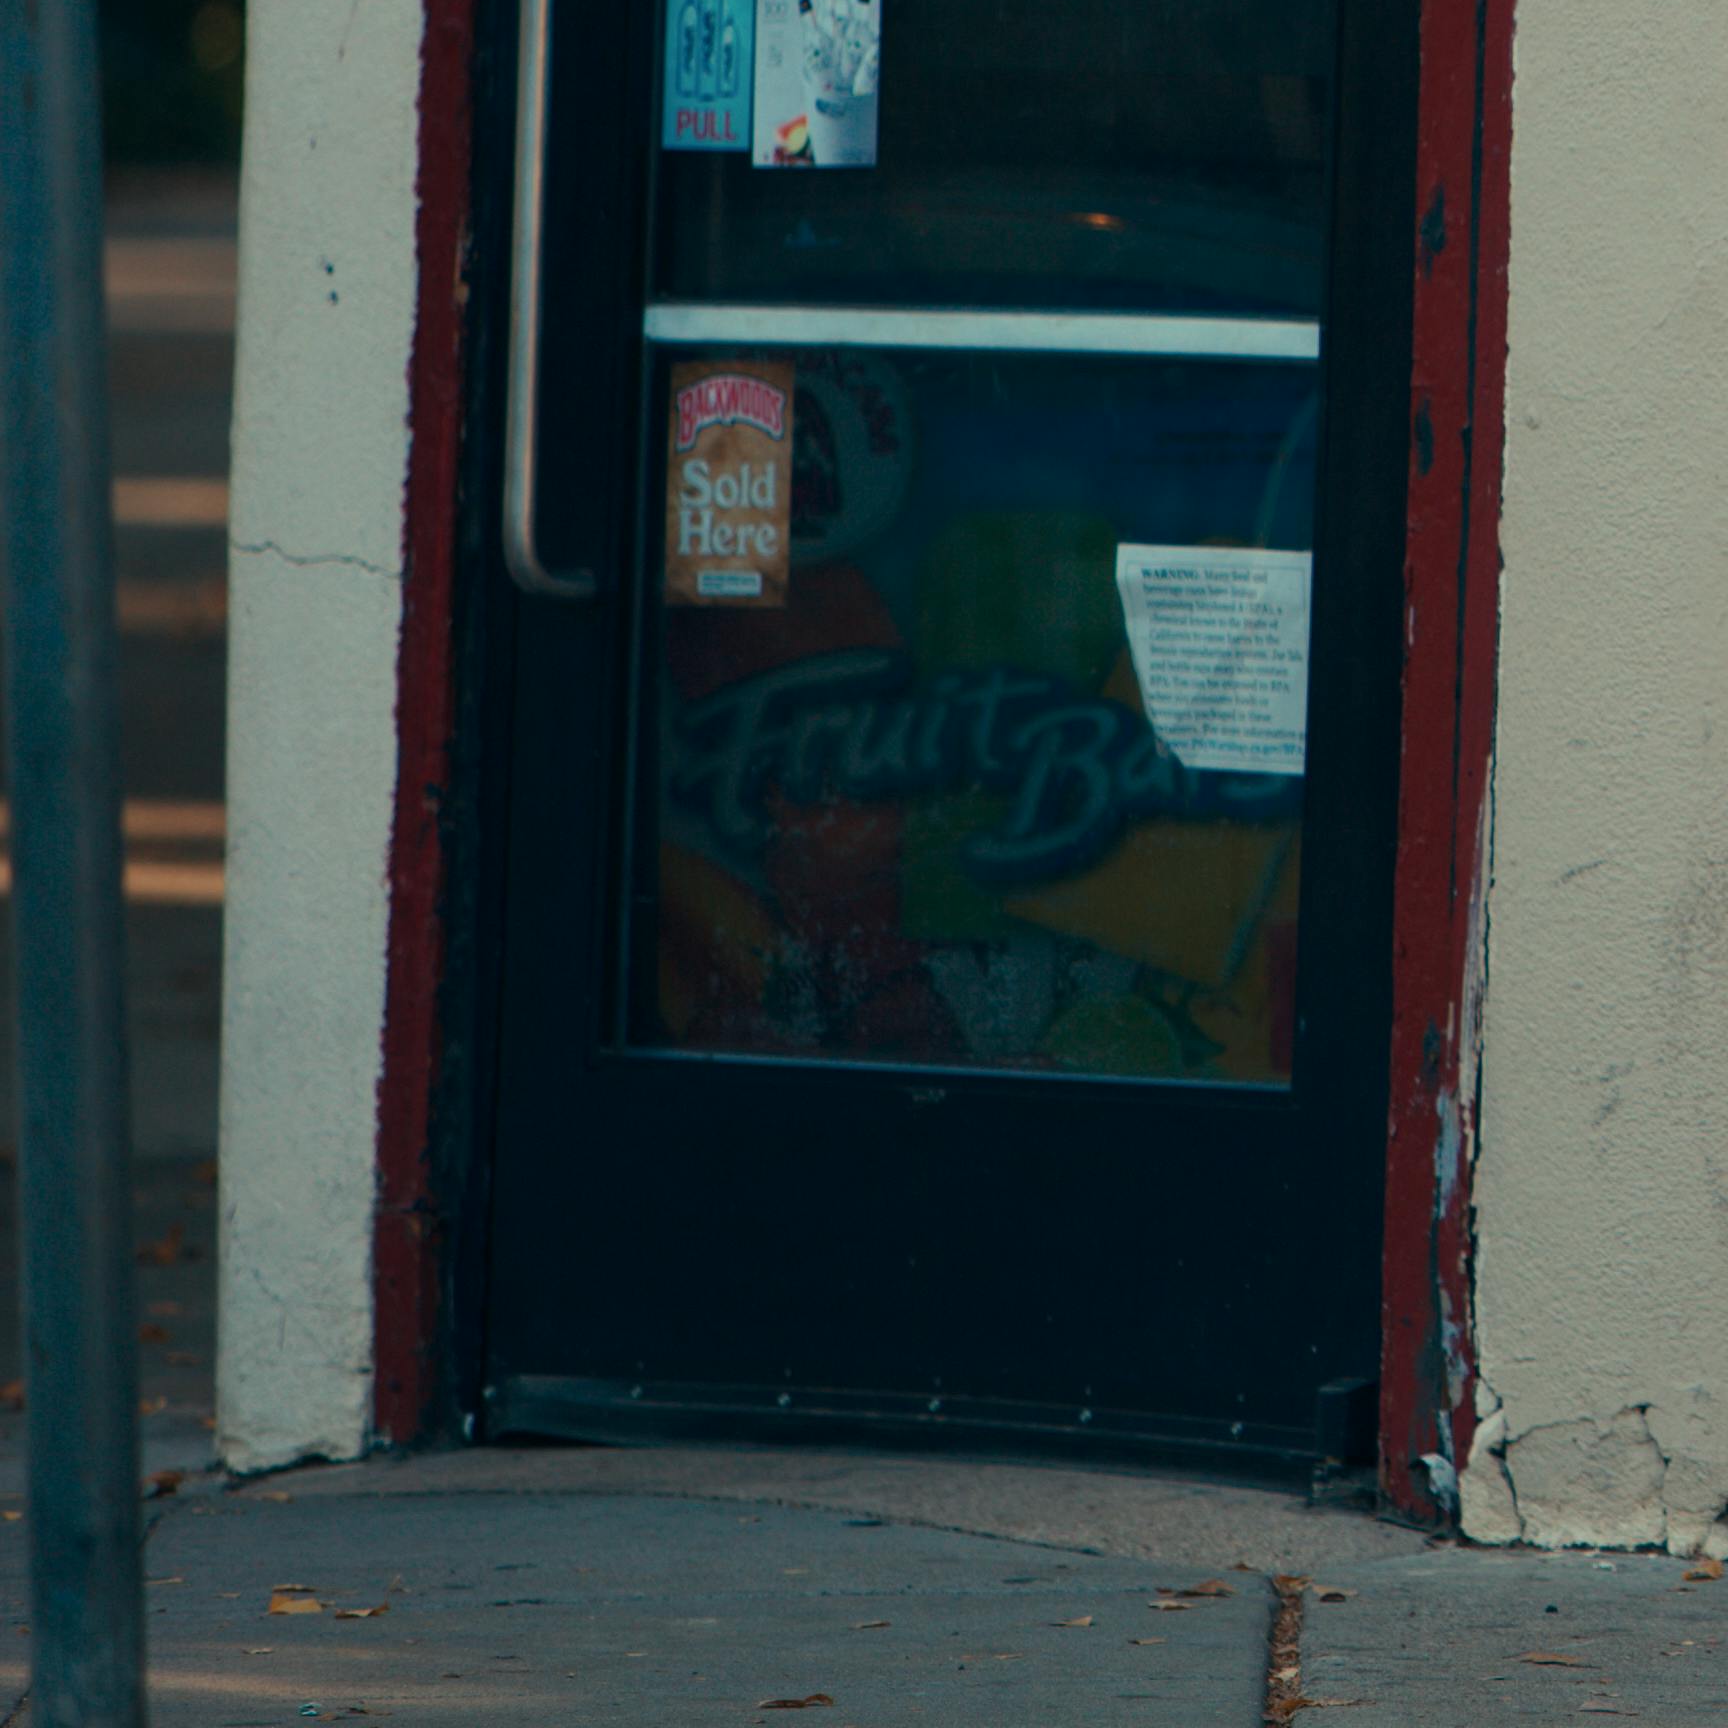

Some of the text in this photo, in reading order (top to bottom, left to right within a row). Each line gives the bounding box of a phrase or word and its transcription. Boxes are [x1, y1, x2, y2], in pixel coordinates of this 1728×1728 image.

[675, 110, 736, 141] PULL
[674, 374, 787, 453] BACKWOODS
[679, 460, 777, 510] Sold
[677, 511, 779, 557] Here
[678, 652, 1050, 834] Fruit
